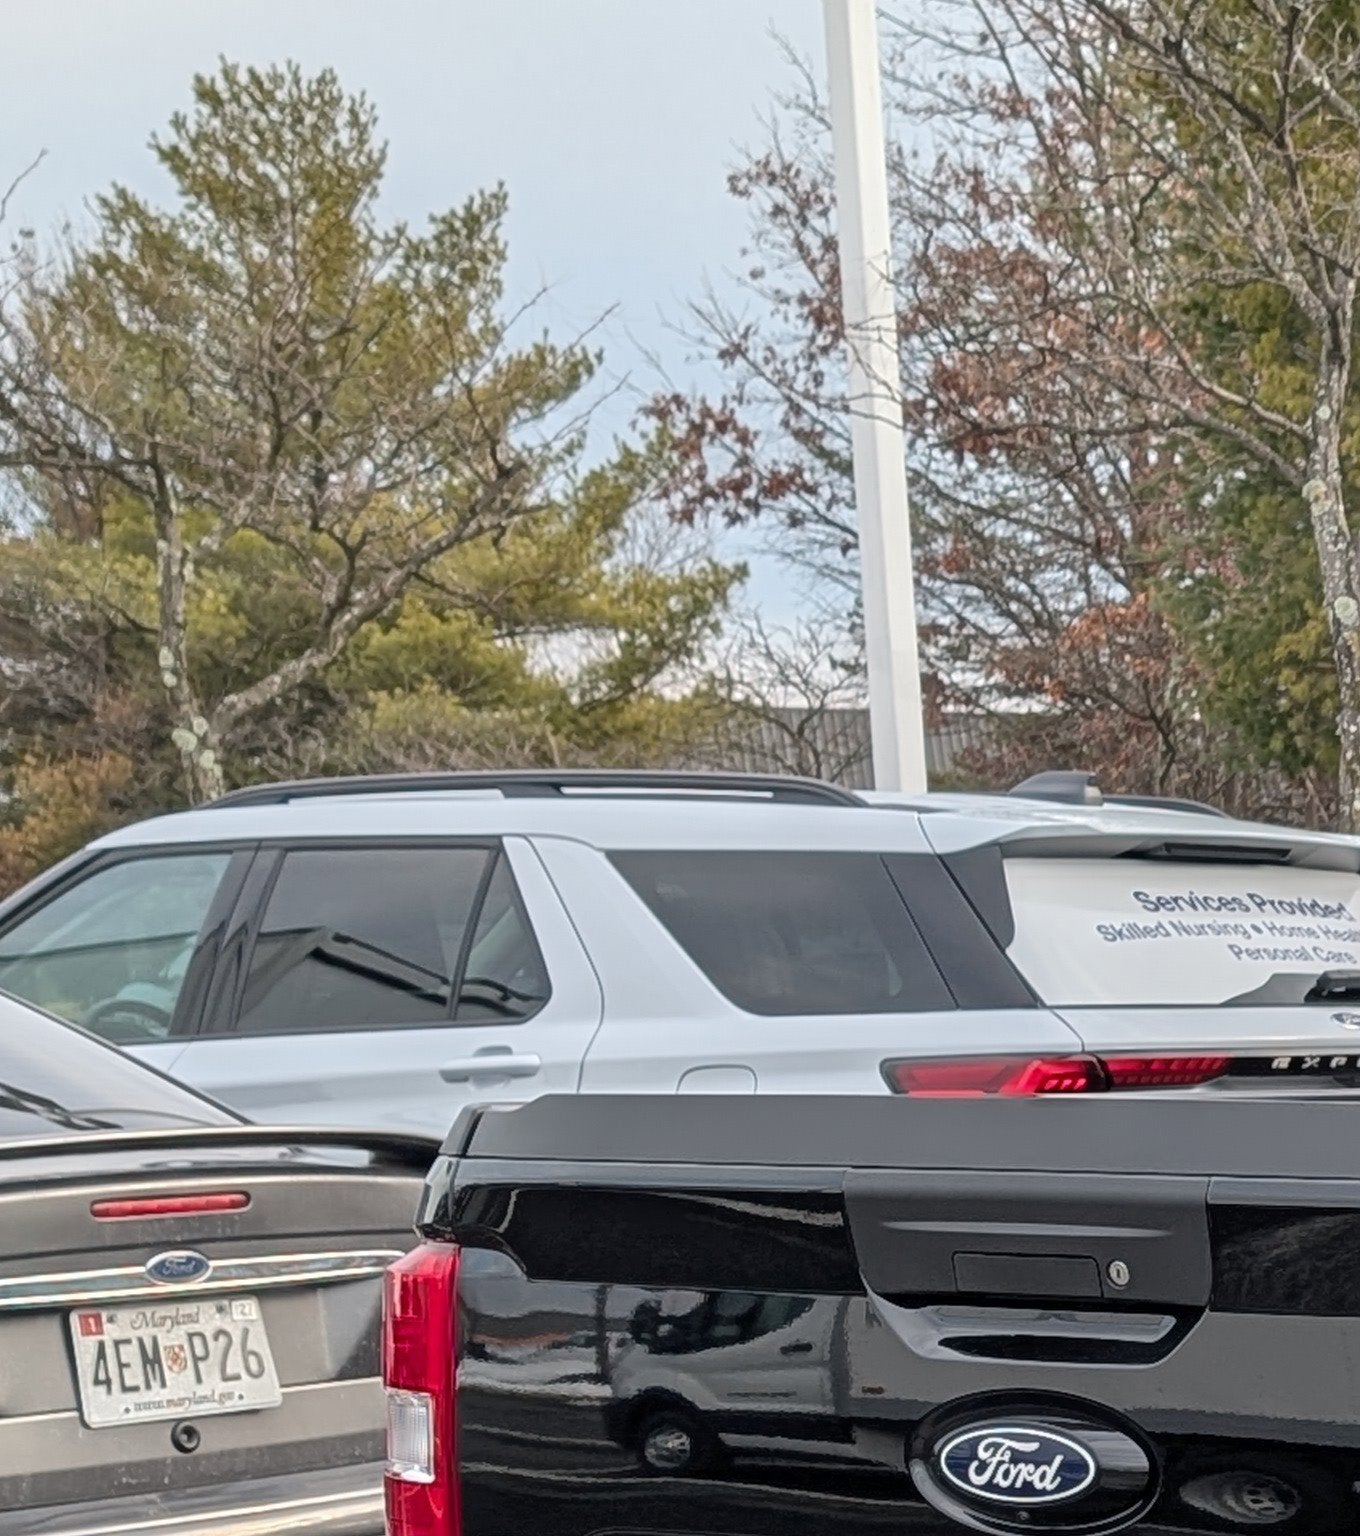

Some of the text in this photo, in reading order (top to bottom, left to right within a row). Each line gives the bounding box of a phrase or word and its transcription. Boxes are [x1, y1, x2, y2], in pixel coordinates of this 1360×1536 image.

[1132, 890, 1355, 921] Services Provided
[1096, 921, 1171, 943] Skilled
[1169, 920, 1251, 941] Nursing
[1262, 921, 1320, 941] Home
[1227, 943, 1357, 965] Personal Care
[131, 1305, 200, 1333] Maryland
[968, 1437, 1065, 1491] Ford
